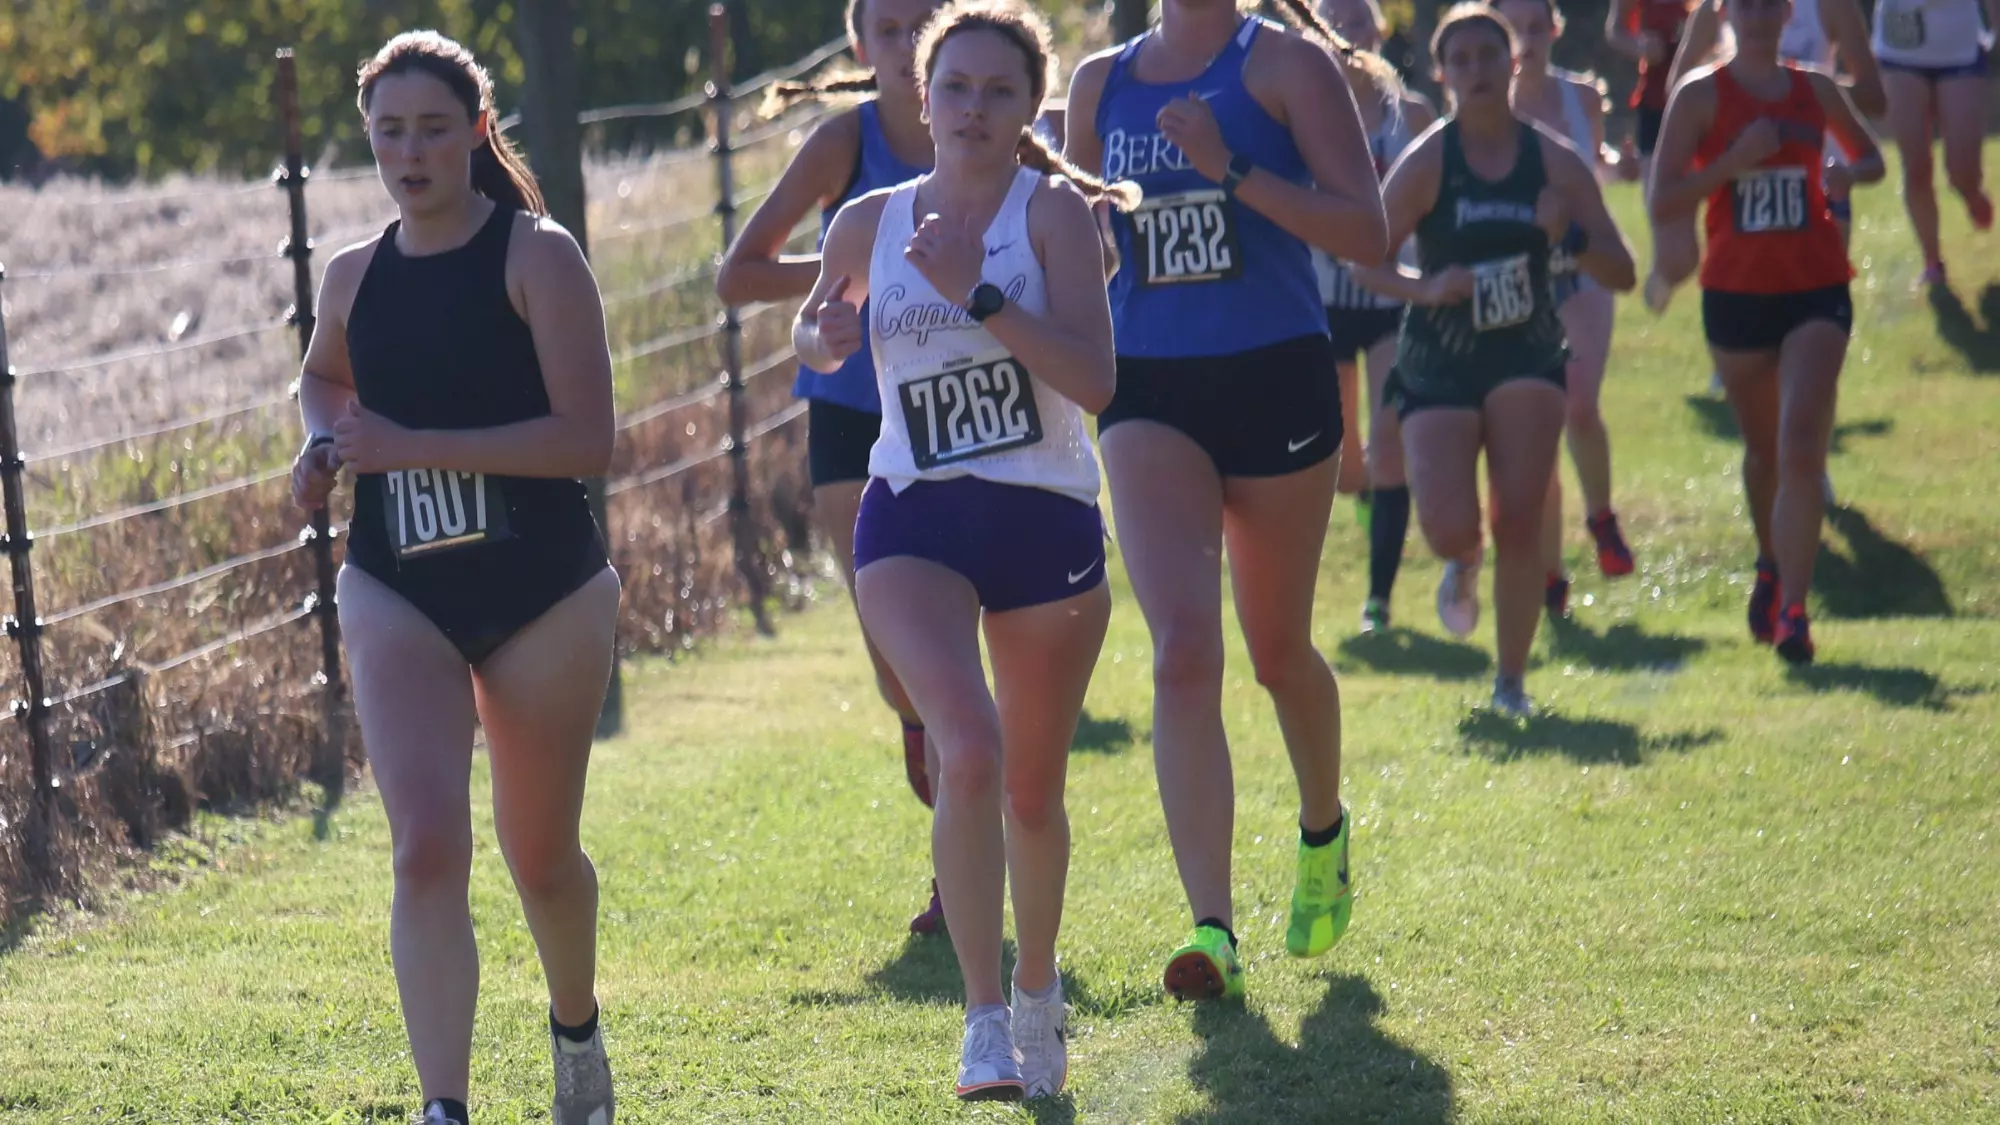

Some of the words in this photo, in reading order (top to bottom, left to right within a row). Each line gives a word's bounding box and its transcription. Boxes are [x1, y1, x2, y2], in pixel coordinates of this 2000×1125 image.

[1134, 204, 1232, 280] 7232
[1737, 178, 1804, 231] 7216
[909, 362, 1029, 455] 7262
[387, 467, 487, 546] 7607
